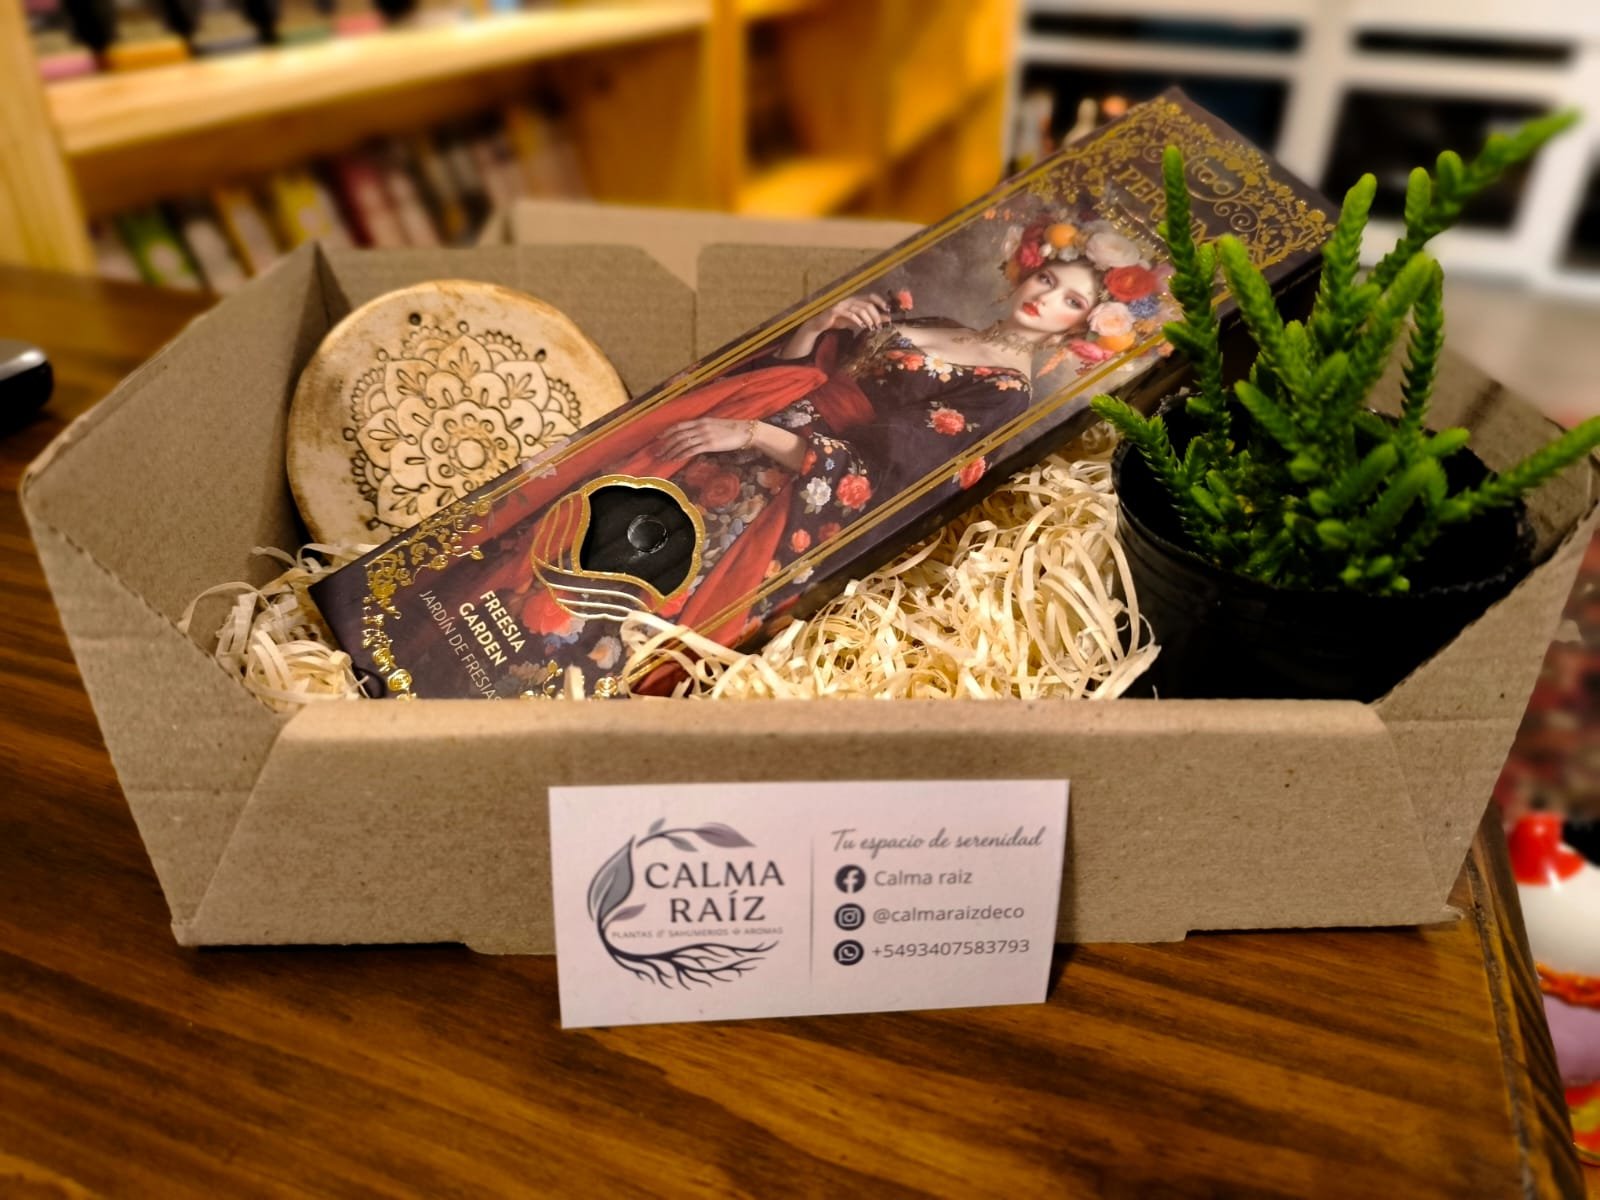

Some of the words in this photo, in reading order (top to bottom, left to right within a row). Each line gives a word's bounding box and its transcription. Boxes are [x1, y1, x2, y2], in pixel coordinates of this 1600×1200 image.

[419, 589, 457, 636] JARDÍN
[449, 633, 469, 656] DE
[458, 602, 507, 667] GARDEN
[479, 590, 528, 653] FREESIA
[831, 828, 856, 850] Tu
[860, 834, 925, 860] espacio
[928, 827, 951, 848] de
[955, 825, 1046, 848] serenidad
[644, 860, 785, 889] CALMA
[873, 870, 933, 887] Calma
[938, 868, 973, 885] raiz
[669, 889, 766, 923] RAÍZ
[872, 904, 1025, 924] @calmaraizdeco
[612, 930, 653, 939] PLANTAS
[744, 927, 783, 936] AROMAS
[871, 938, 1030, 958] +5493407583793
